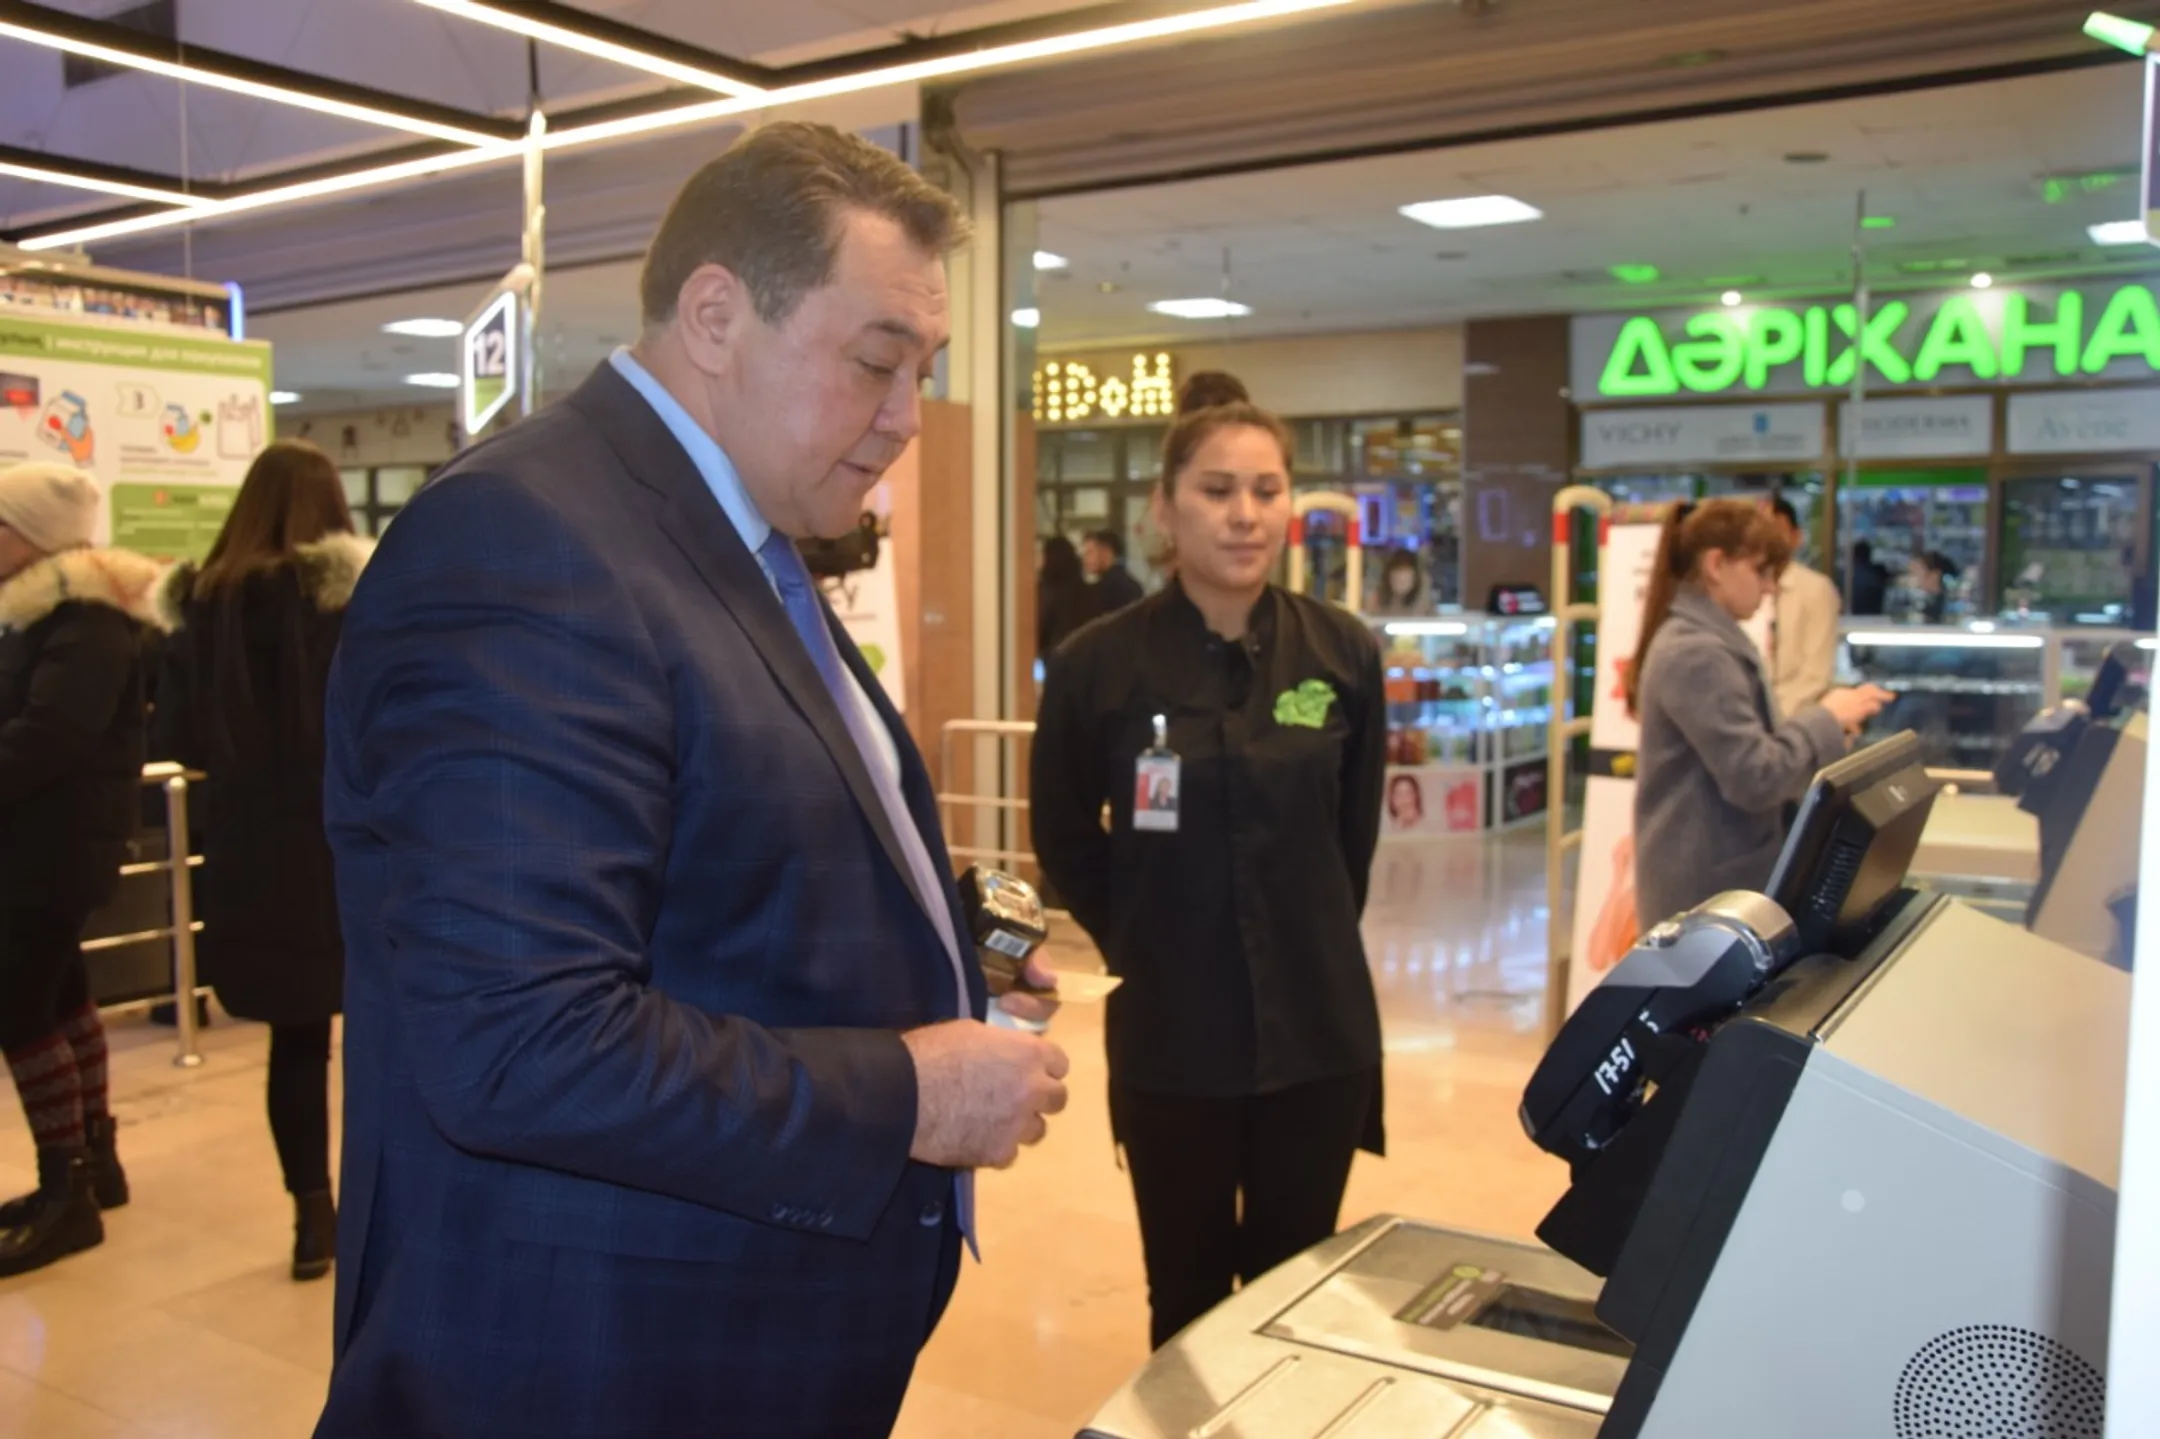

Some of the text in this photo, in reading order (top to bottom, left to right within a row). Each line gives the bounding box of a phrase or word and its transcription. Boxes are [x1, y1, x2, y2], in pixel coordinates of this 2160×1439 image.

[473, 328, 506, 376] 12
[1599, 287, 2160, 395] ДӘРІХАНА
[1598, 420, 1683, 446] VICHY
